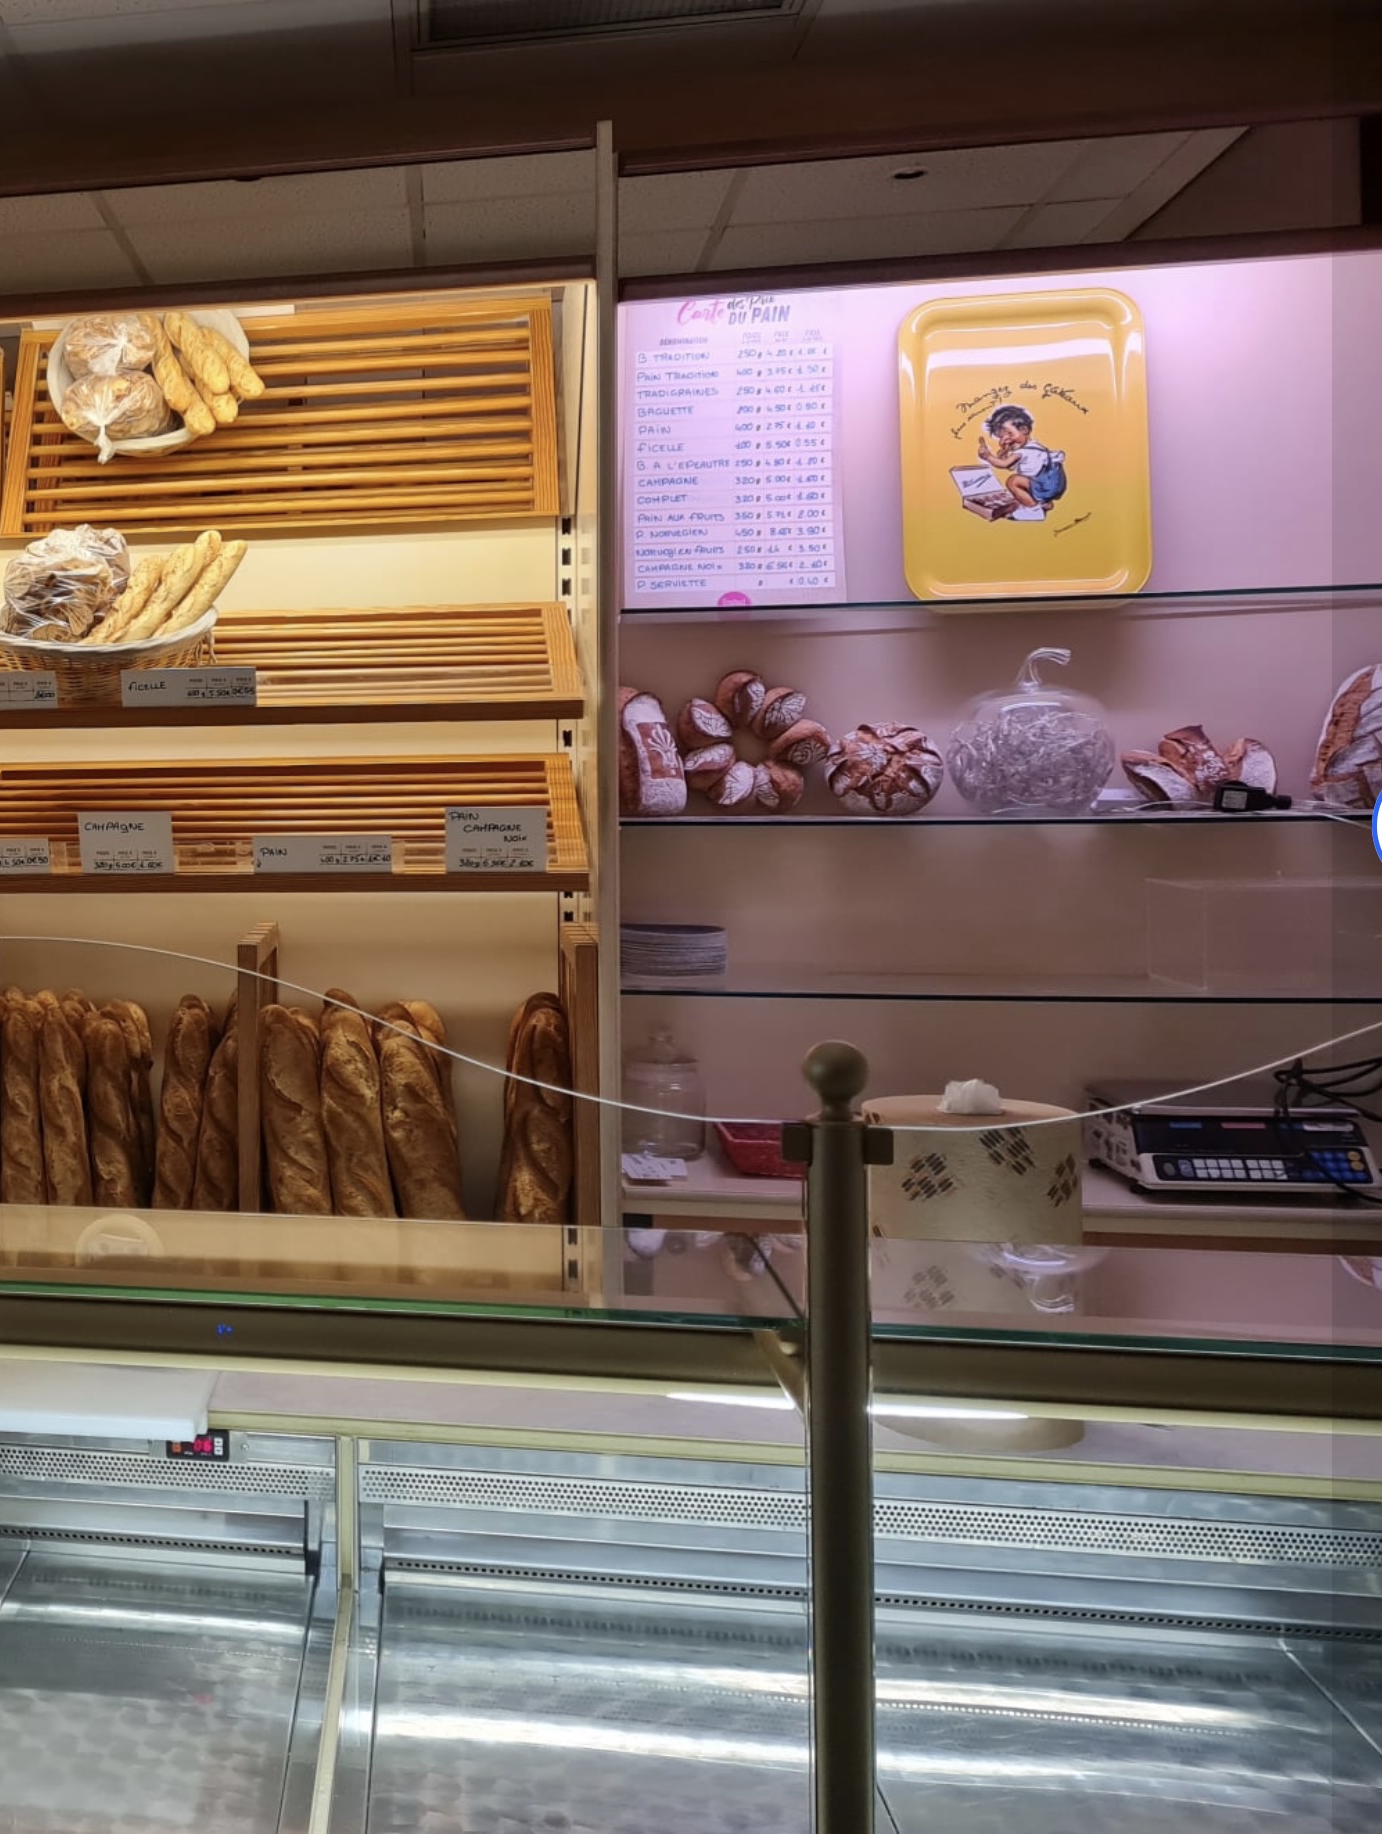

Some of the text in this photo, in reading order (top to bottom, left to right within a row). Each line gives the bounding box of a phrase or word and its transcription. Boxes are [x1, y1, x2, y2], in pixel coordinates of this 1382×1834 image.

[677, 299, 725, 325] Carte
[728, 305, 791, 325] DU PAIN
[653, 352, 709, 361] TRADITION
[665, 371, 719, 380] TRADITION
[637, 387, 719, 399] TRADIGRAINES
[637, 406, 694, 417] BAGUETTE
[638, 477, 698, 487] CAMPAGNE
[637, 495, 687, 505] COMPLET
[638, 563, 693, 573] CAMPAGNE
[650, 579, 707, 589] SERVIETTE
[84, 821, 145, 833] CAMPAGNE
[463, 823, 522, 832] CAMPAGNE
